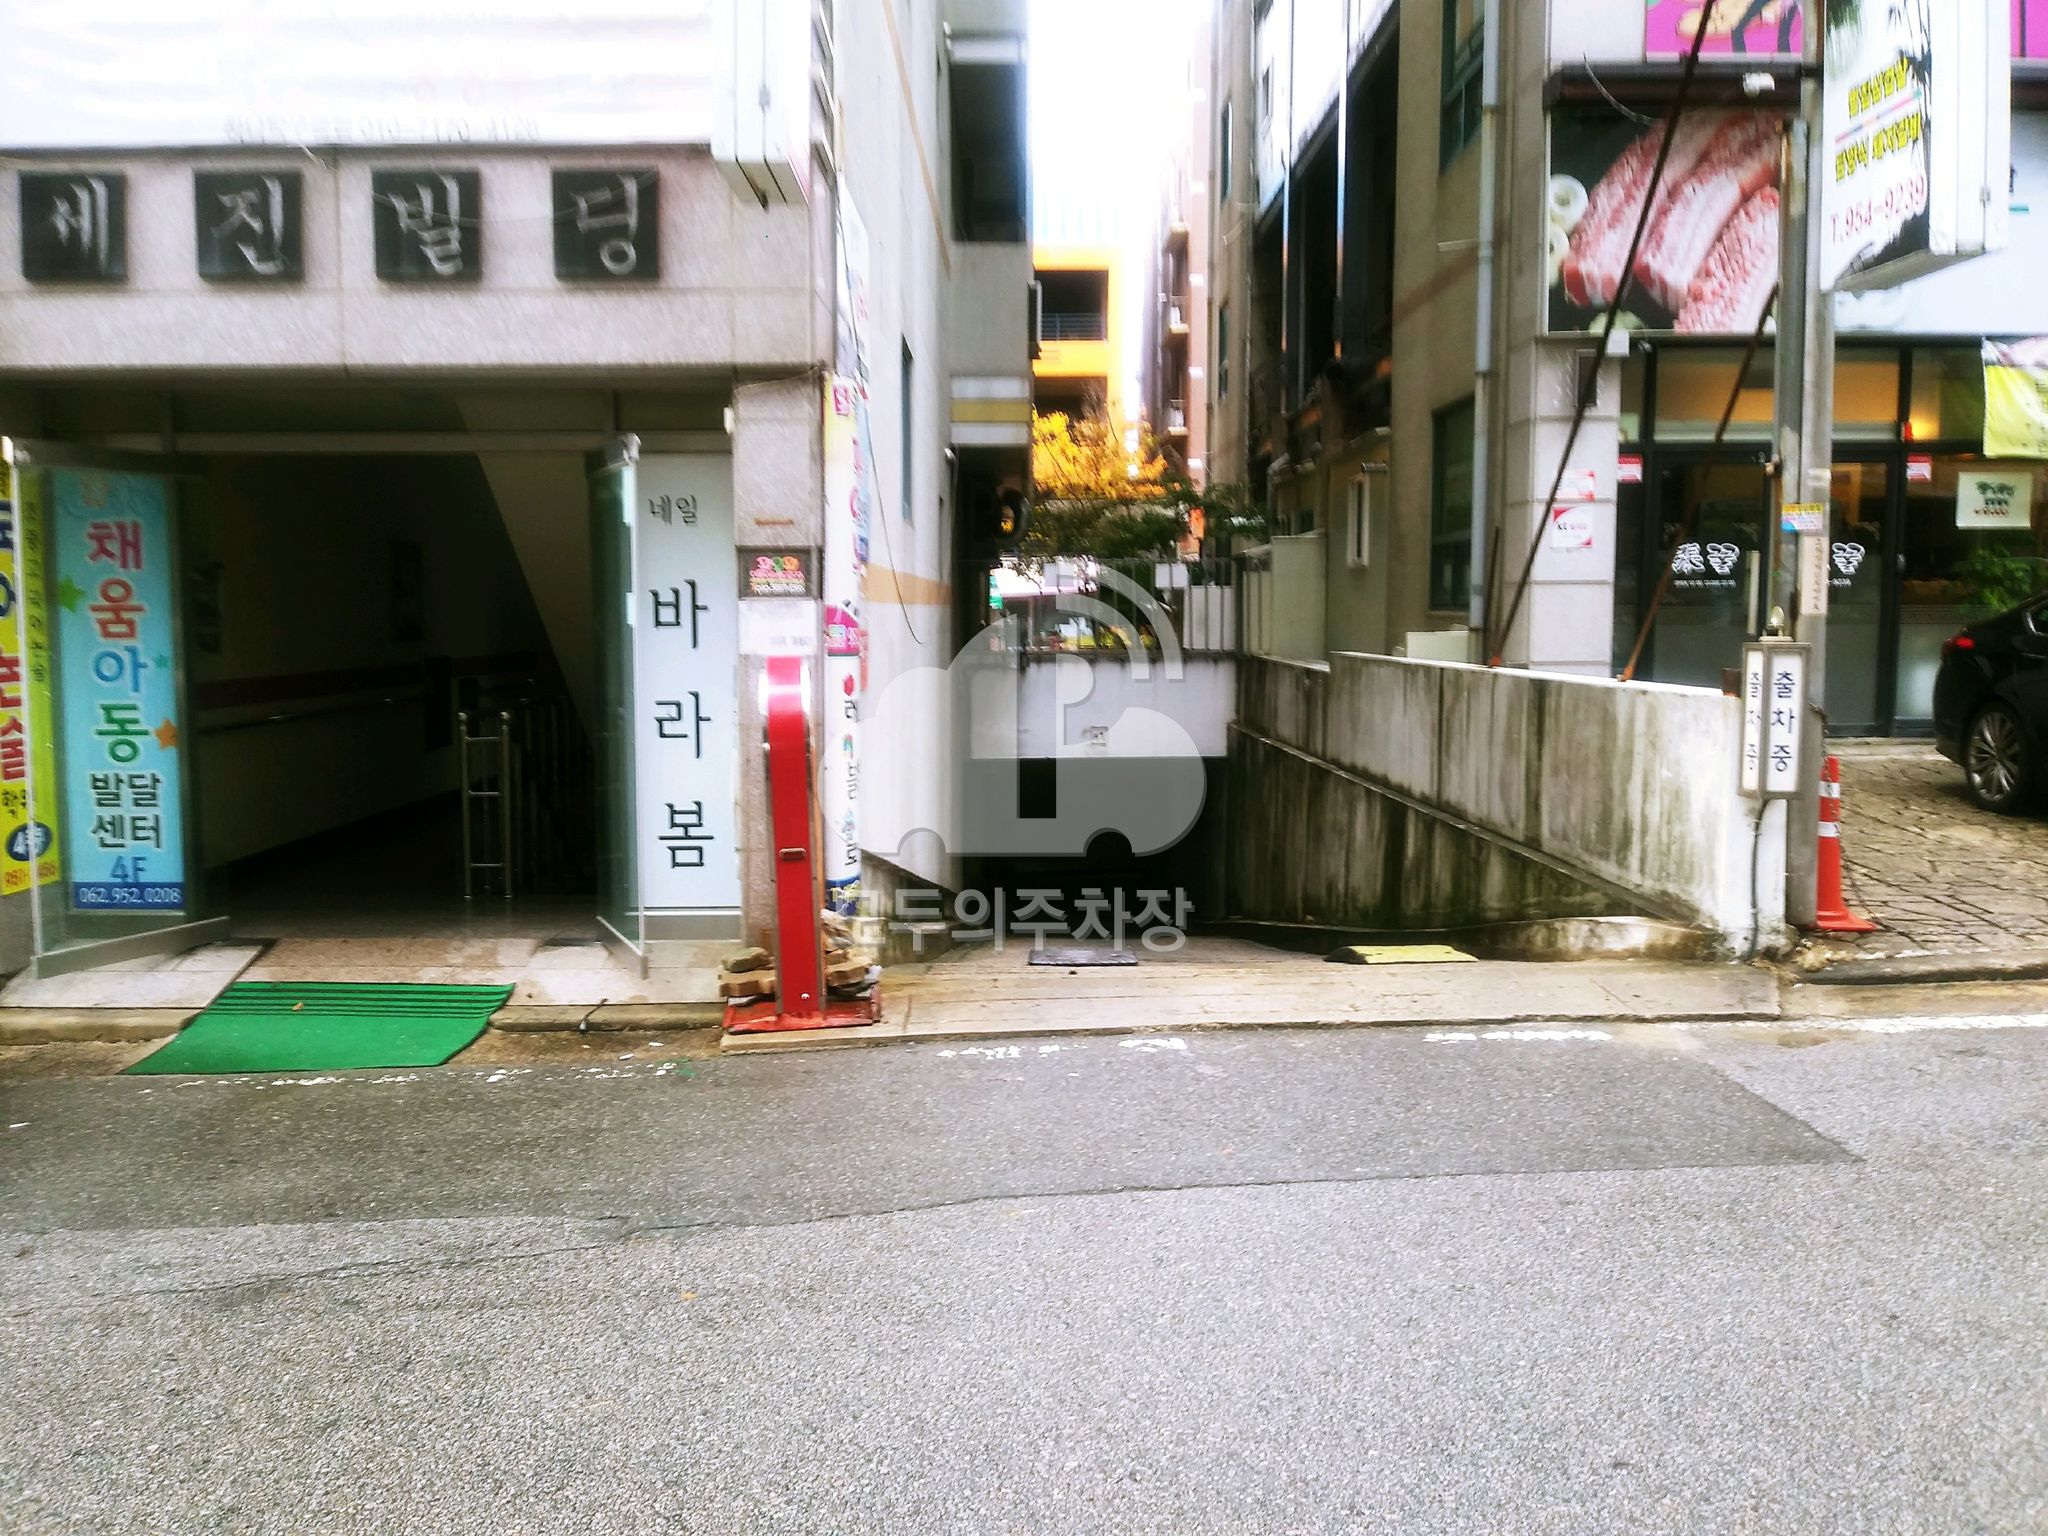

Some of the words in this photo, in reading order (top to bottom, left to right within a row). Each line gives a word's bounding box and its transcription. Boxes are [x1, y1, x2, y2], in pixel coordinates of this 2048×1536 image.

[50, 172, 641, 275] 세진빌딩
[648, 494, 699, 527] 네일
[86, 520, 150, 764] 채움아동
[648, 578, 716, 870] 바라봄
[1769, 671, 1796, 773] 출차중
[89, 772, 163, 808] 발달
[90, 813, 162, 849] 센터
[110, 855, 148, 882] 4F
